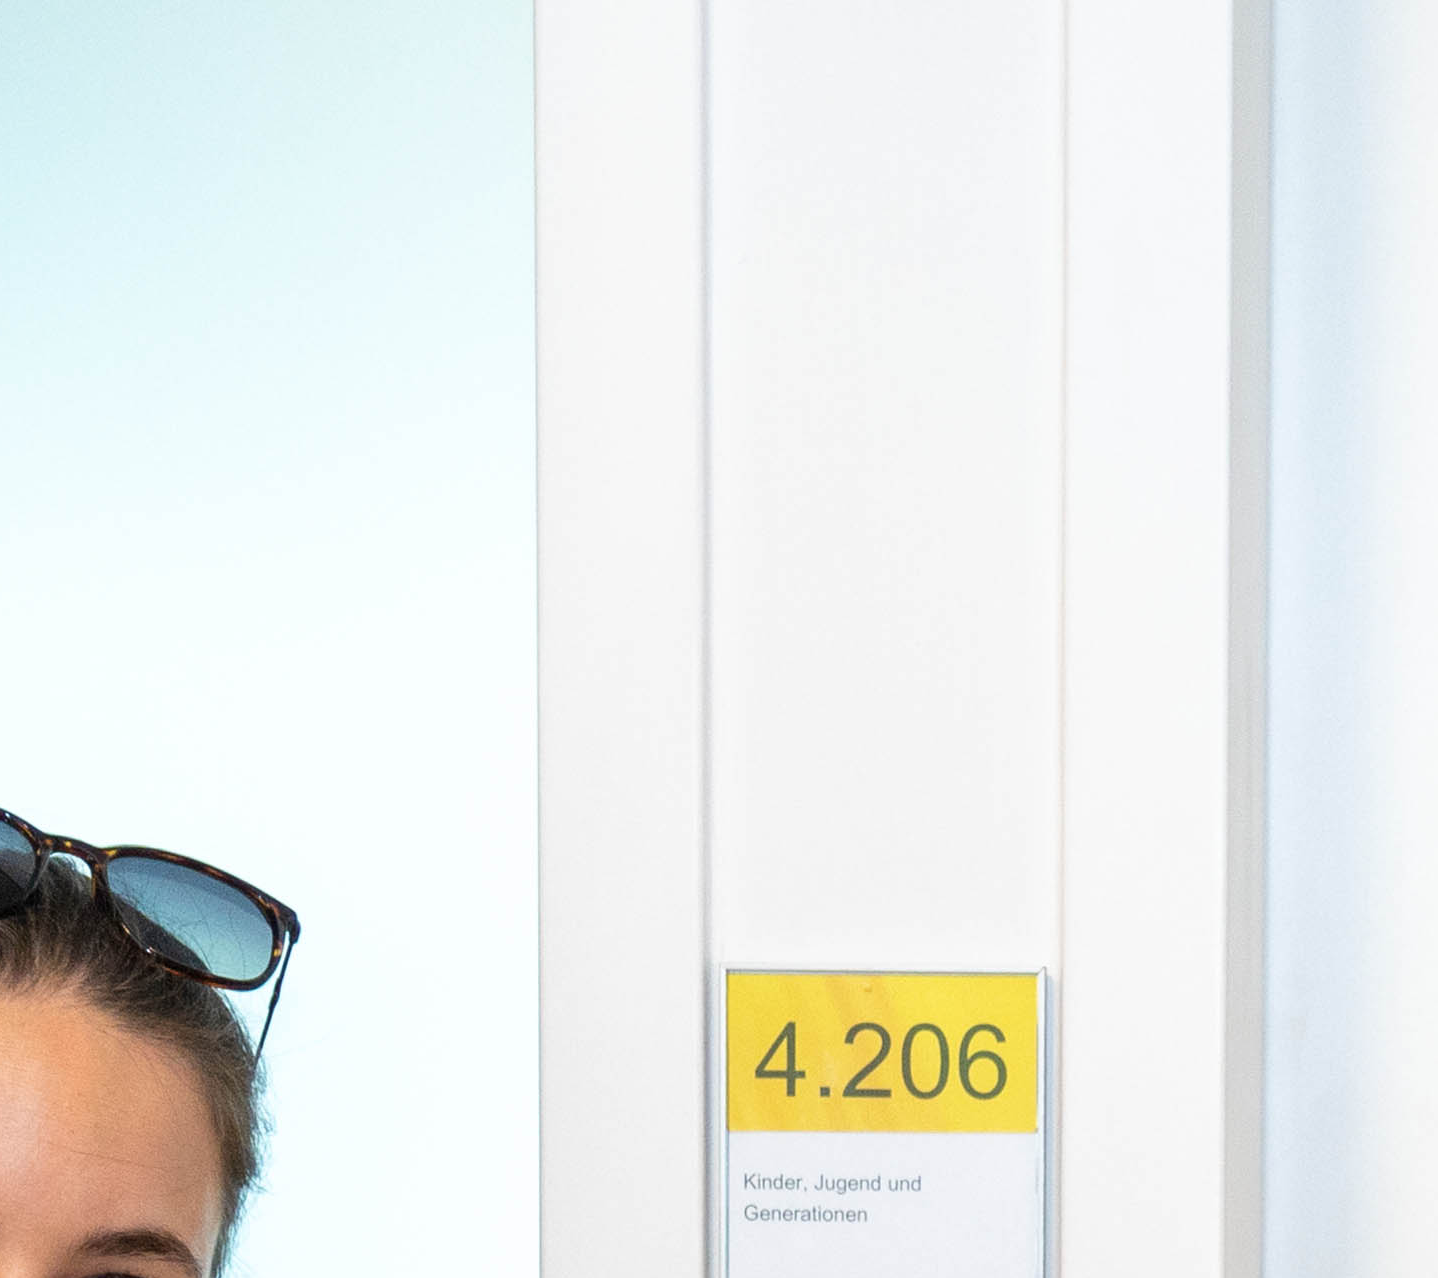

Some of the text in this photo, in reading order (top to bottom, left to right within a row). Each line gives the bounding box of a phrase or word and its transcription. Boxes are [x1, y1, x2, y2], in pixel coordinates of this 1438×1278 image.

[754, 1021, 1008, 1100] 4.206
[743, 1173, 922, 1195] Kinder, Jugend und
[743, 1204, 868, 1223] Generationen
